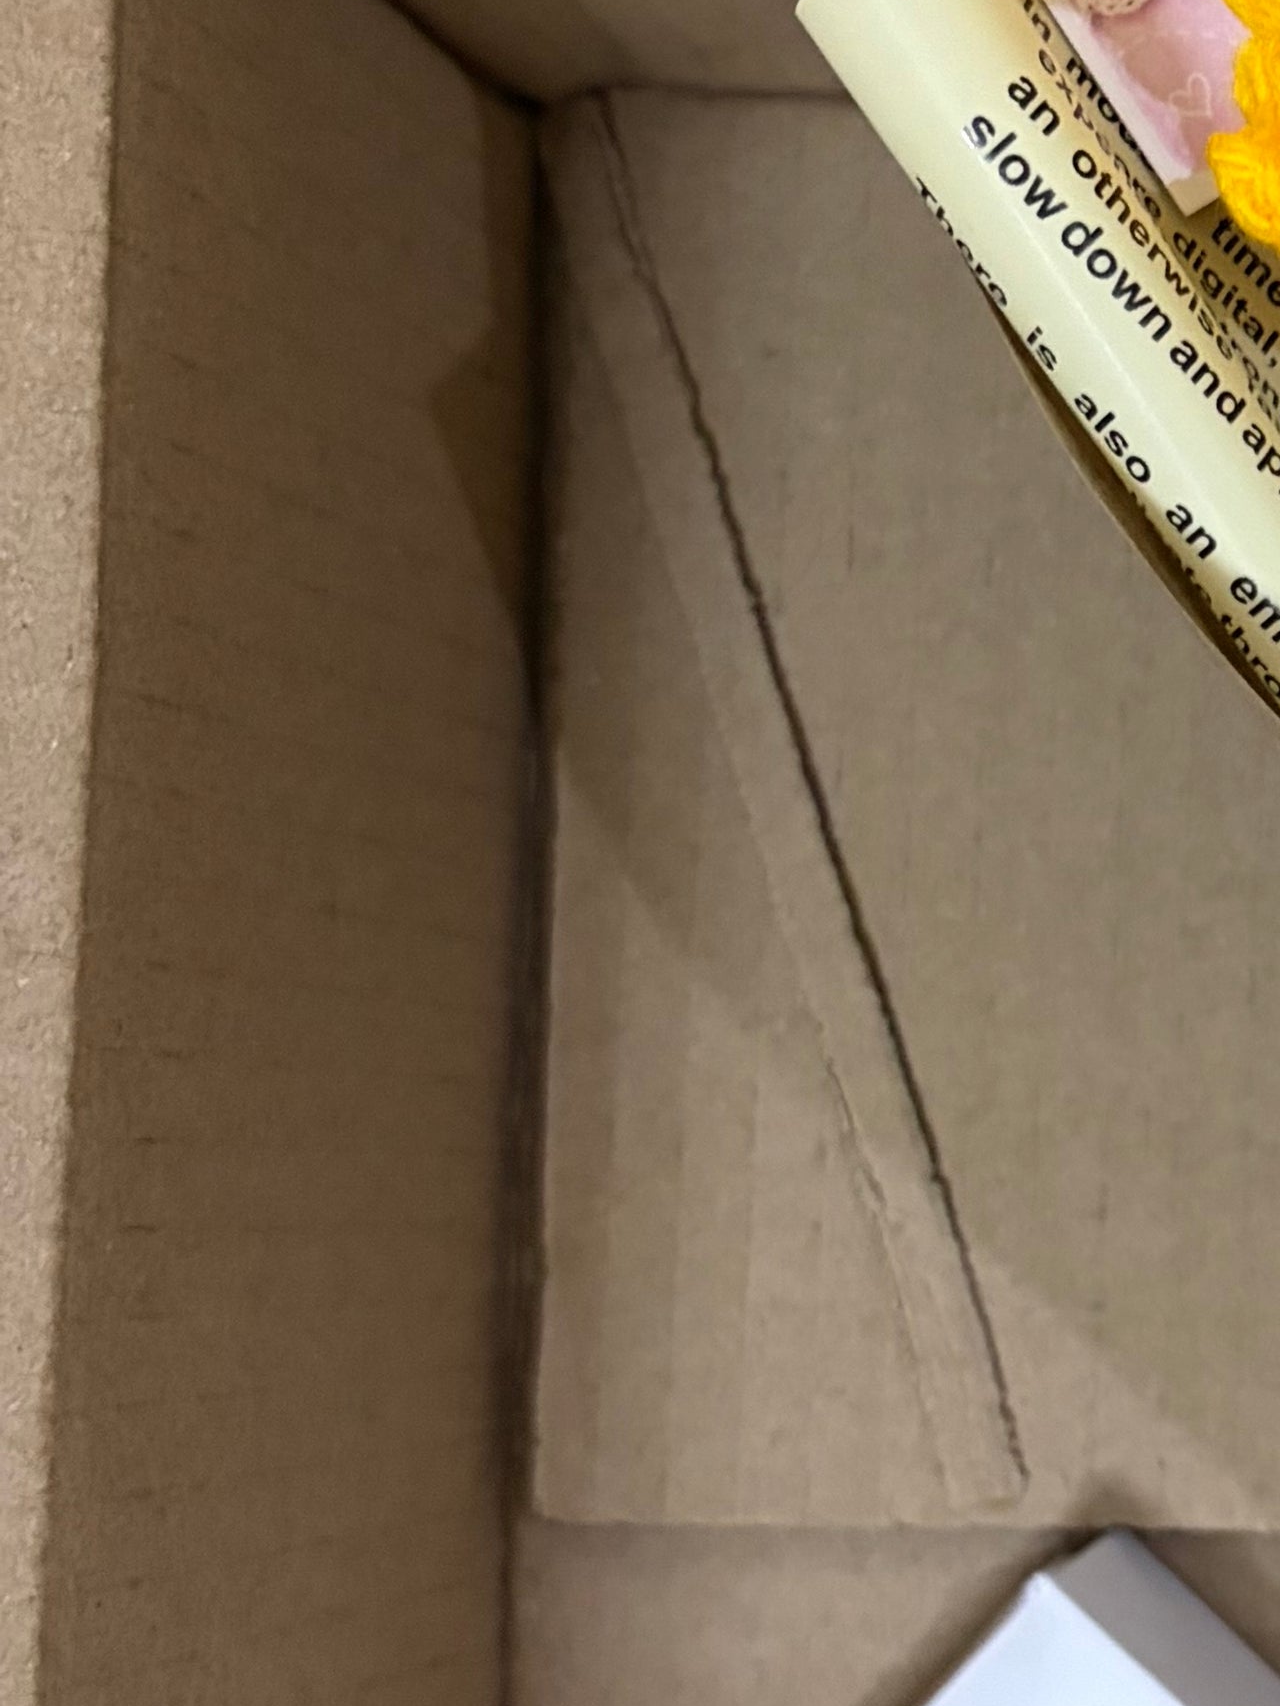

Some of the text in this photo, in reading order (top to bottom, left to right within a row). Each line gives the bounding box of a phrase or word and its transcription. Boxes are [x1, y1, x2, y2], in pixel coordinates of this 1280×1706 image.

[1007, 76, 1061, 136] an
[963, 115, 1068, 221] slow
[1061, 220, 1173, 343] down
[1169, 339, 1247, 424] and
[1173, 230, 1280, 369] digital,
[1026, 325, 1058, 372] is
[1073, 393, 1152, 483] also
[1165, 503, 1218, 560] an
